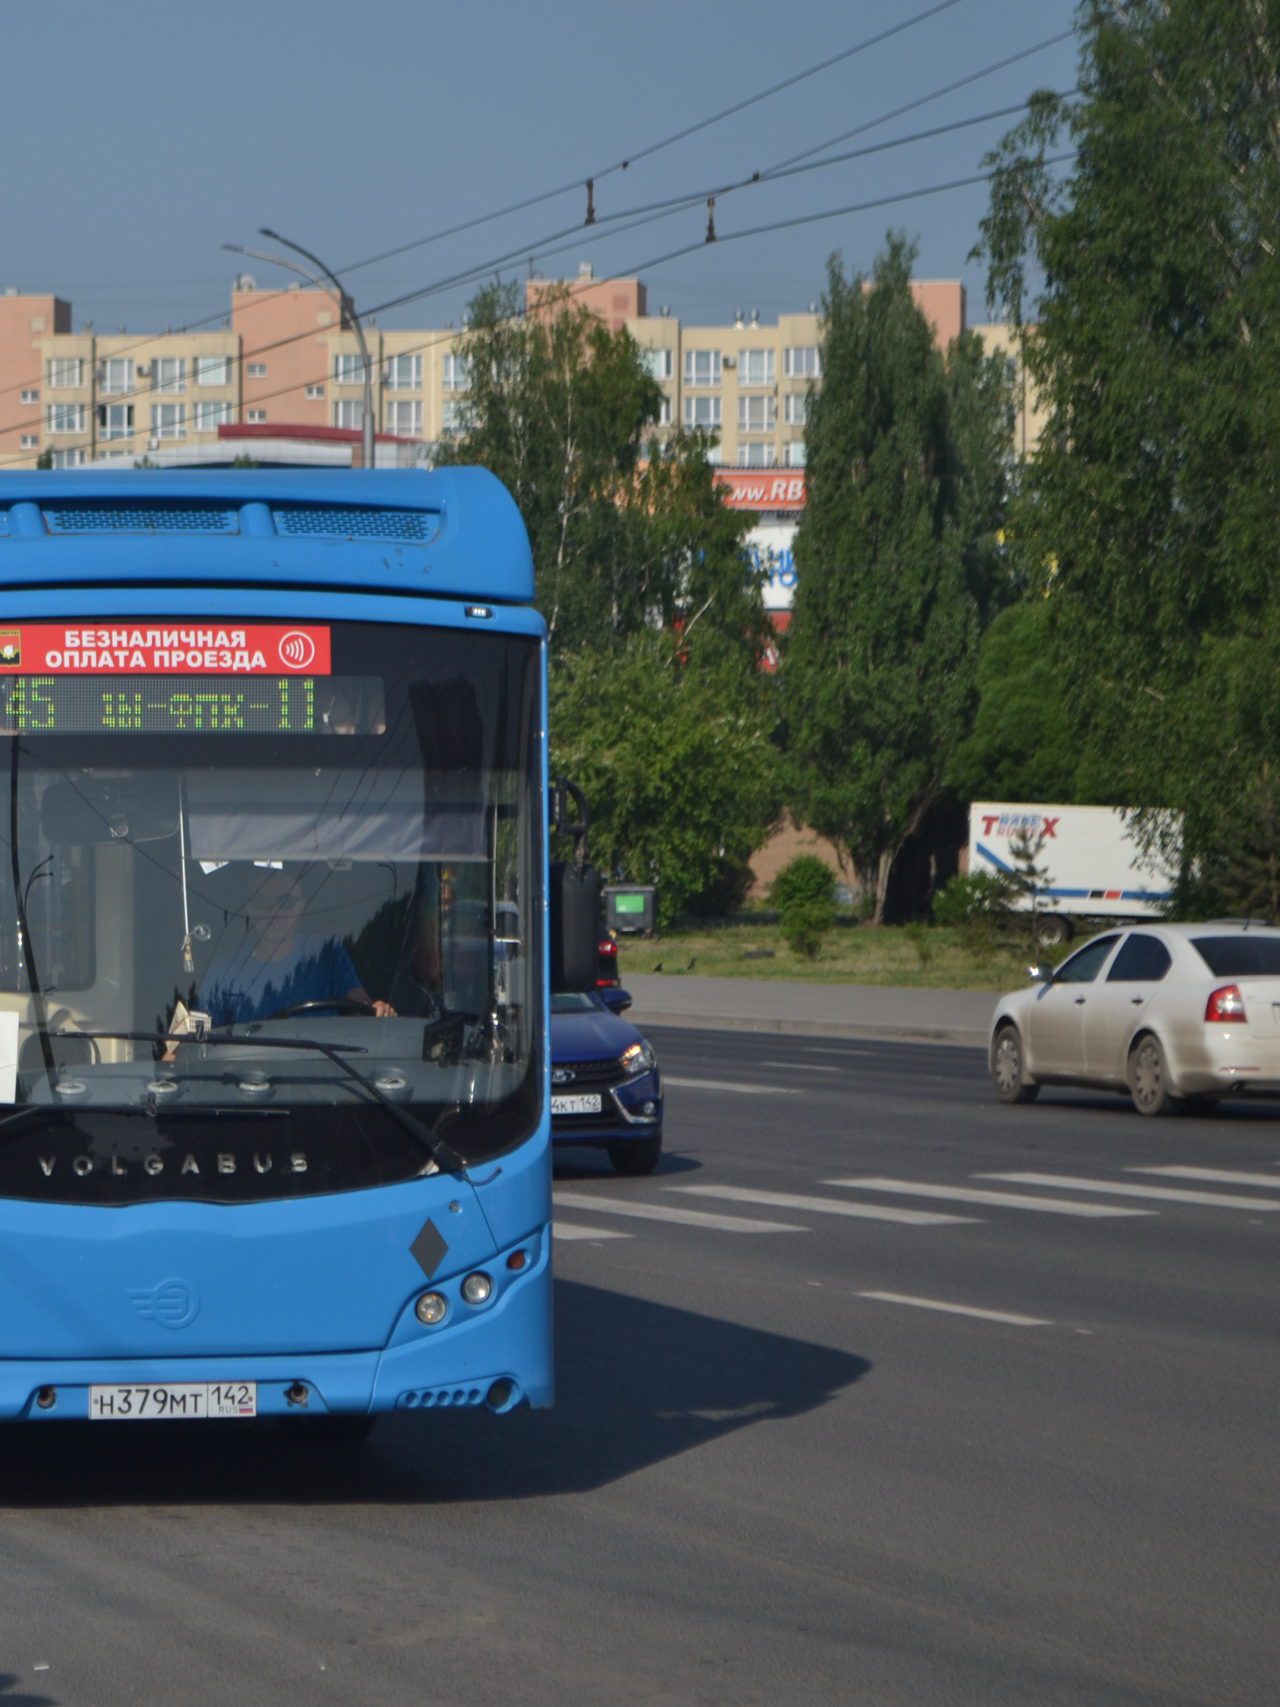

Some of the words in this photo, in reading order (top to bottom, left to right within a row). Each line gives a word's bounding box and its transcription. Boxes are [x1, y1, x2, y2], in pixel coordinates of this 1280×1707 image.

[64, 630, 246, 648] БЕЗНАЛИЧНАЯ
[45, 650, 147, 668] ОПЛАТА
[153, 650, 267, 671] ПРОЕЗДА
[6, 677, 55, 728] 45
[552, 1098, 577, 1113] 4КТ
[37, 1153, 308, 1176] VOLGABUS
[99, 1388, 203, 1415] Н379МТ
[211, 1385, 249, 1405] 142
[218, 1405, 239, 1414] RUS
